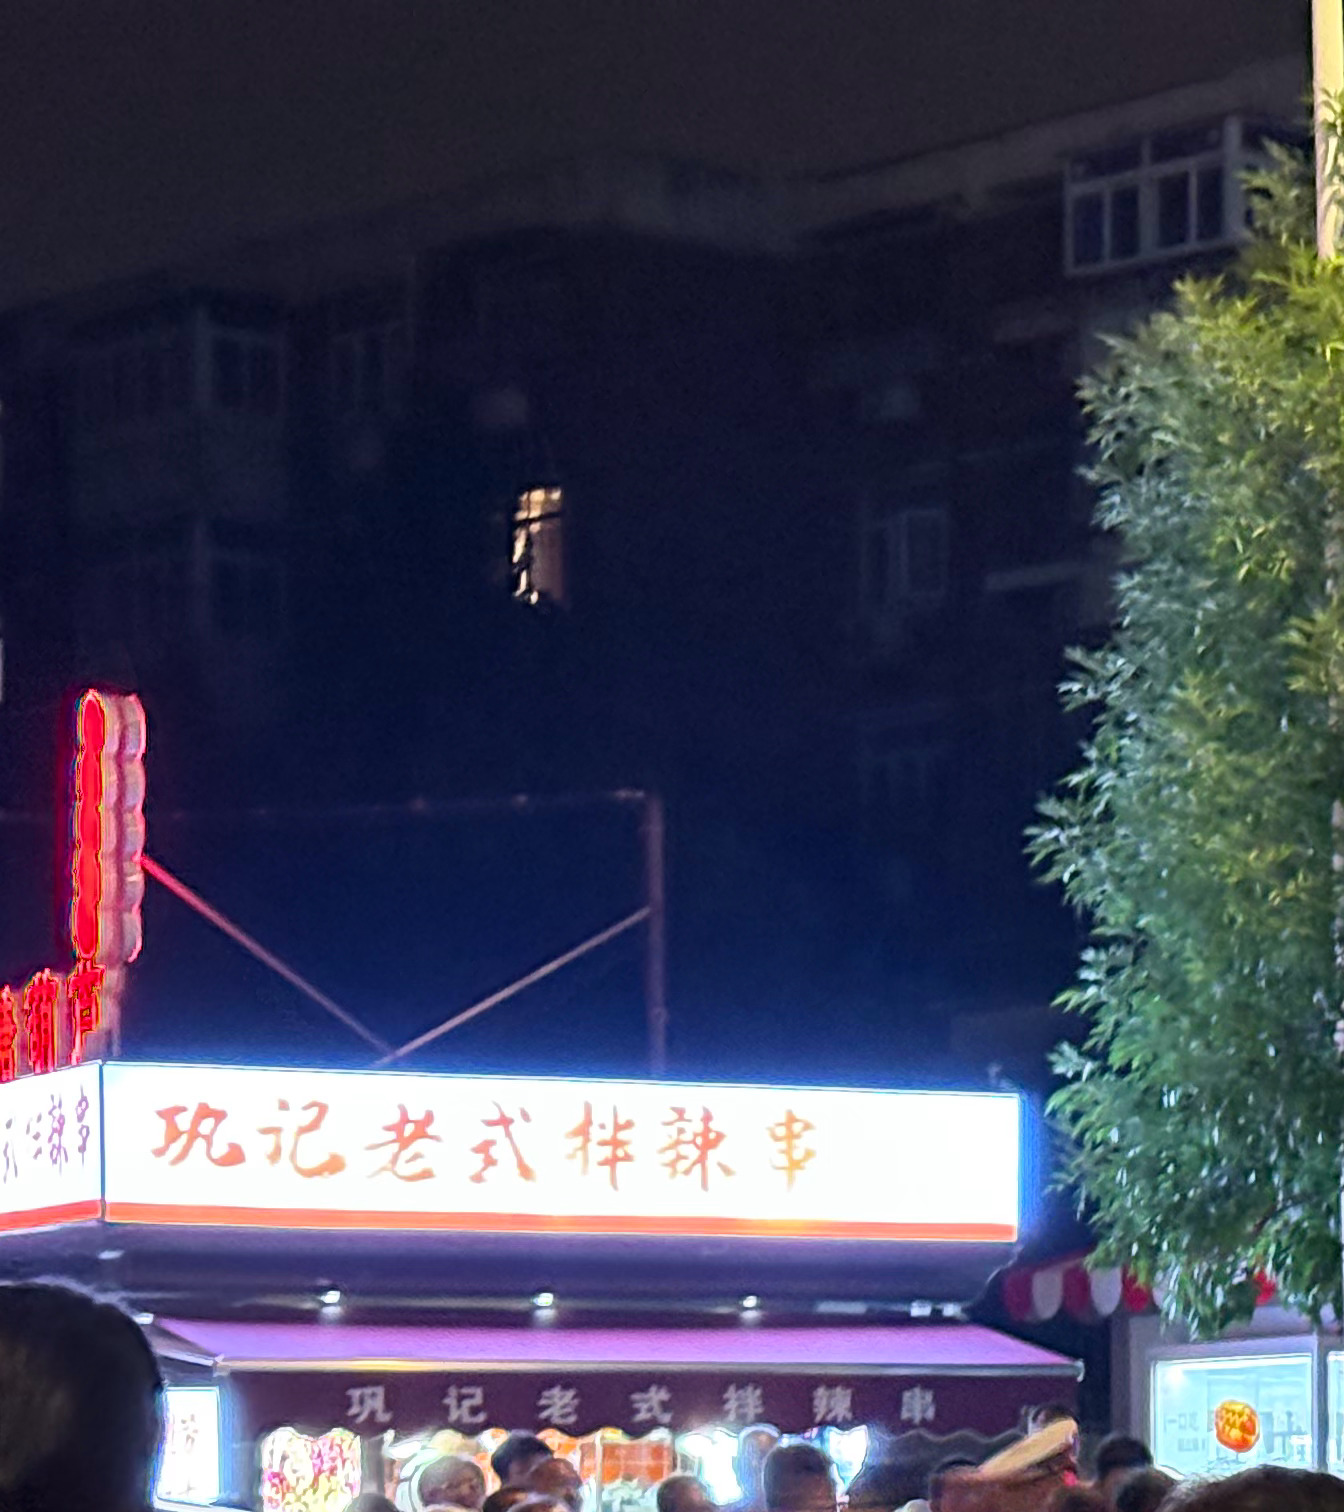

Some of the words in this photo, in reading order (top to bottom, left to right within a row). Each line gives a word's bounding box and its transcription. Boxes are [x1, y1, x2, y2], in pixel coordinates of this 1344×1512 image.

[150, 1099, 819, 1192] 巩记老式拌辣串
[346, 1384, 936, 1424] 巩记老式拌辣串
